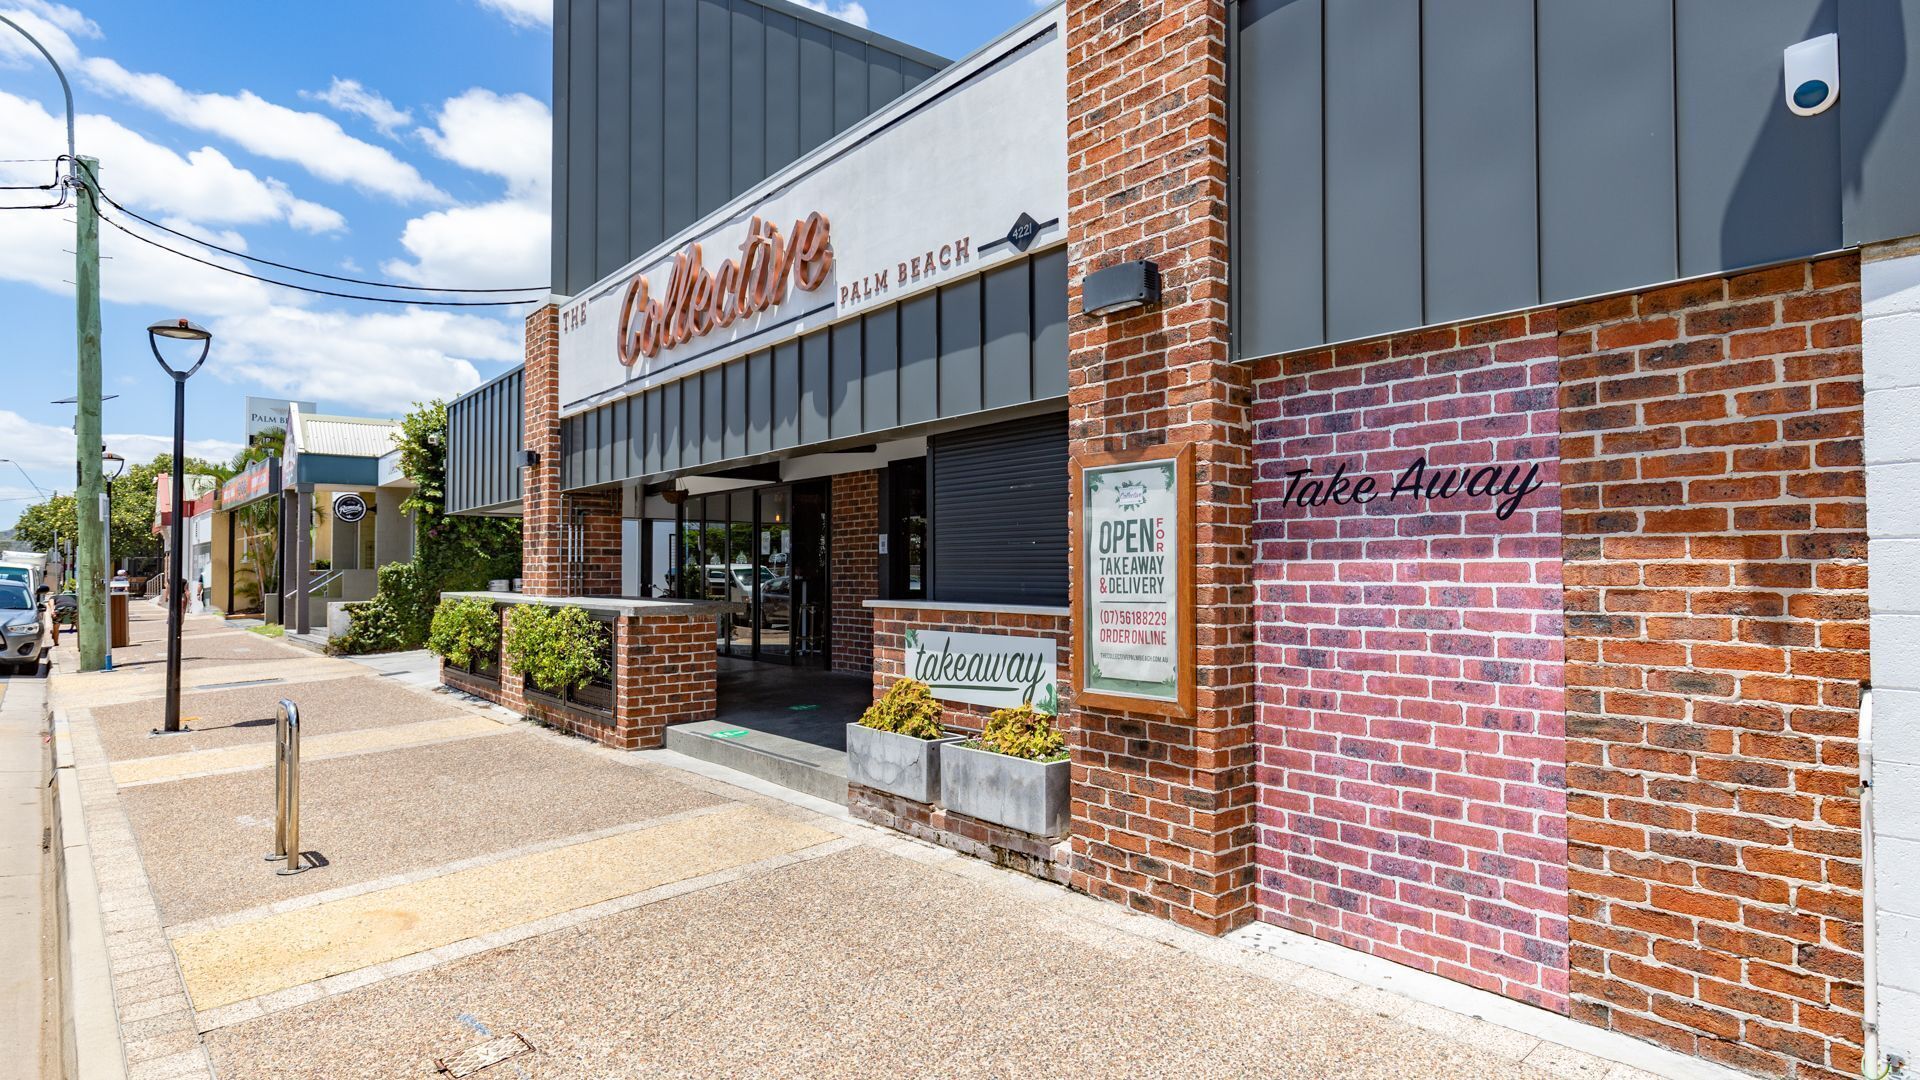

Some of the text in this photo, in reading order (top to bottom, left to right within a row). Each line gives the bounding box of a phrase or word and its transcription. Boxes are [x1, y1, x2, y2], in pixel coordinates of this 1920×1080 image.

[1012, 225, 1032, 240] 4221
[840, 236, 970, 305] PALM BEACH
[617, 210, 834, 367] Collective
[563, 301, 587, 332] THE
[252, 413, 277, 423] PALM
[1282, 456, 1544, 521] Take Away
[1099, 517, 1154, 554] OPEN
[1156, 517, 1165, 552] FOR
[1100, 556, 1165, 575] TAKEAWAY
[1109, 576, 1165, 594] DELIVERY
[1100, 628, 1167, 646] ORDER ONLINE
[915, 636, 1046, 704] takeaway
